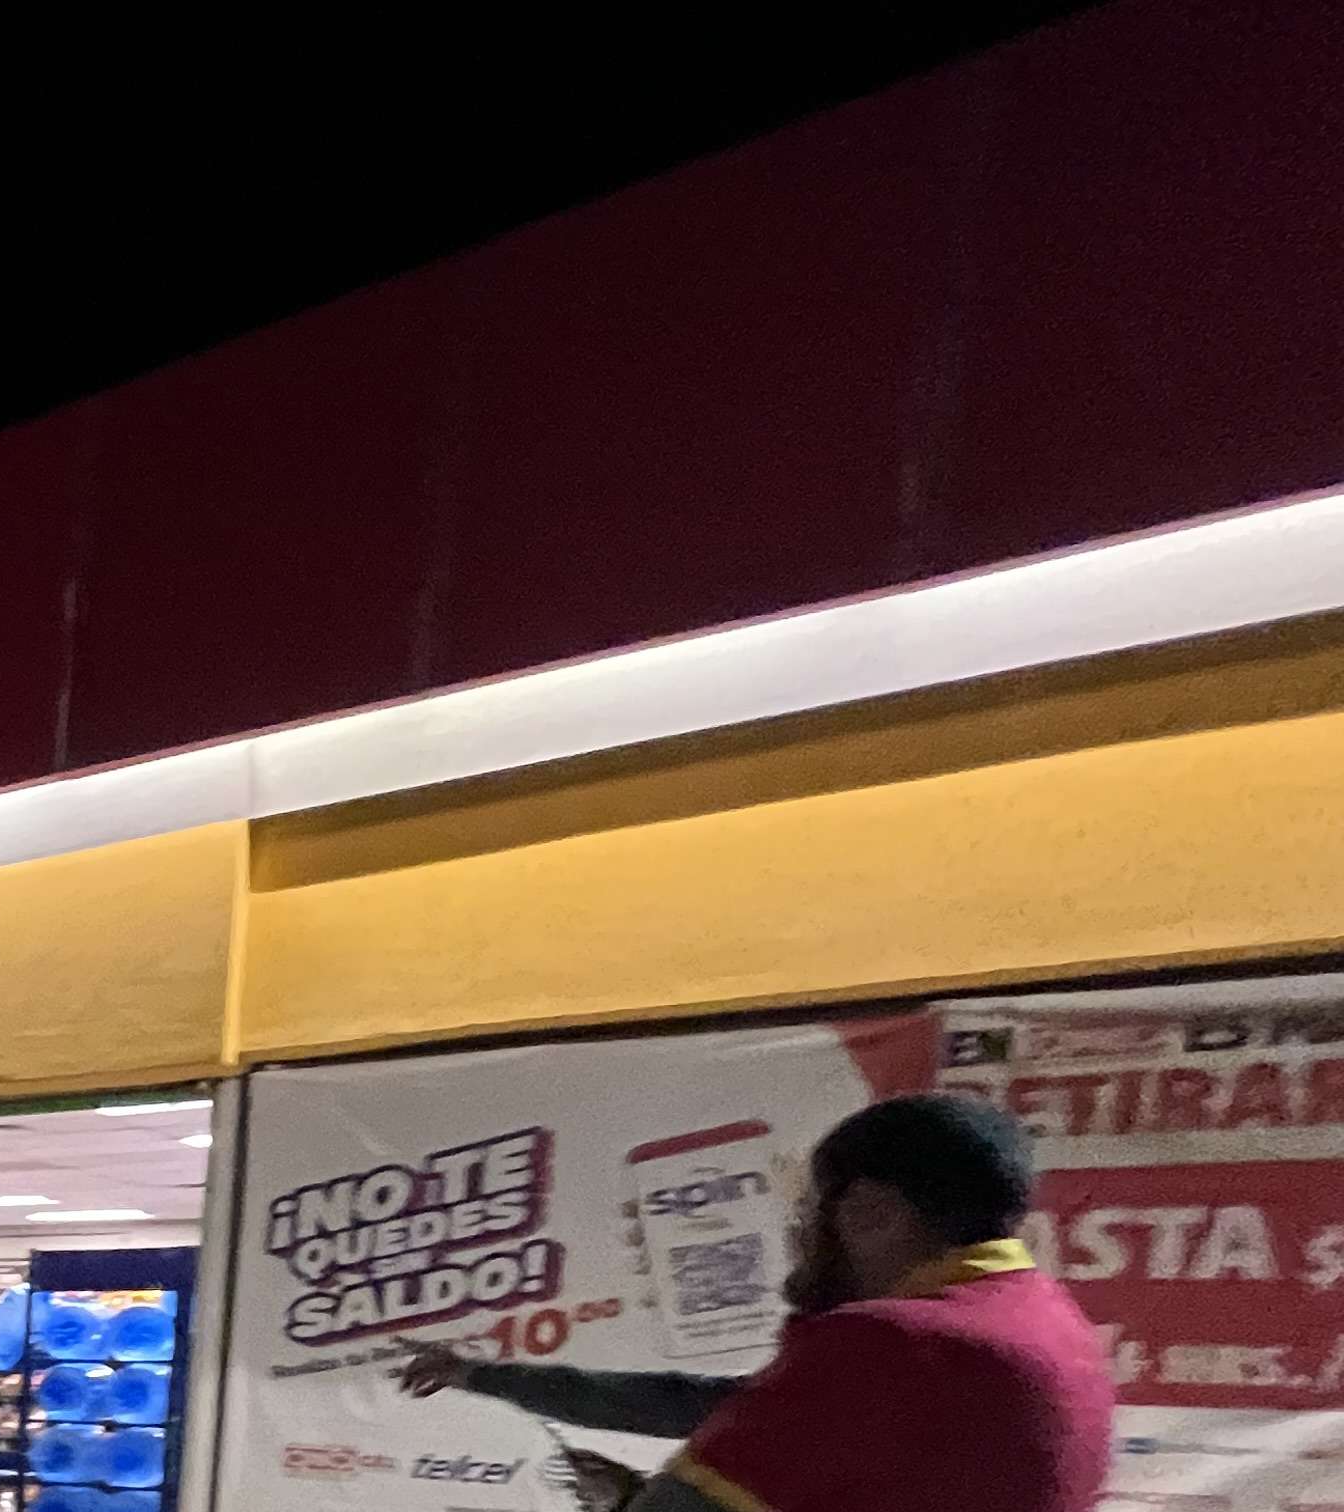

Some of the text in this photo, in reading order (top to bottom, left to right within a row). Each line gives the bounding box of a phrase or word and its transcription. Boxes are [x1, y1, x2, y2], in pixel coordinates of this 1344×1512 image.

[268, 1134, 537, 1252] ¡NO TE
[293, 1193, 529, 1284] QUEDES
[289, 1240, 549, 1338] SALDO!
[1017, 1205, 1280, 1280] ASTA
